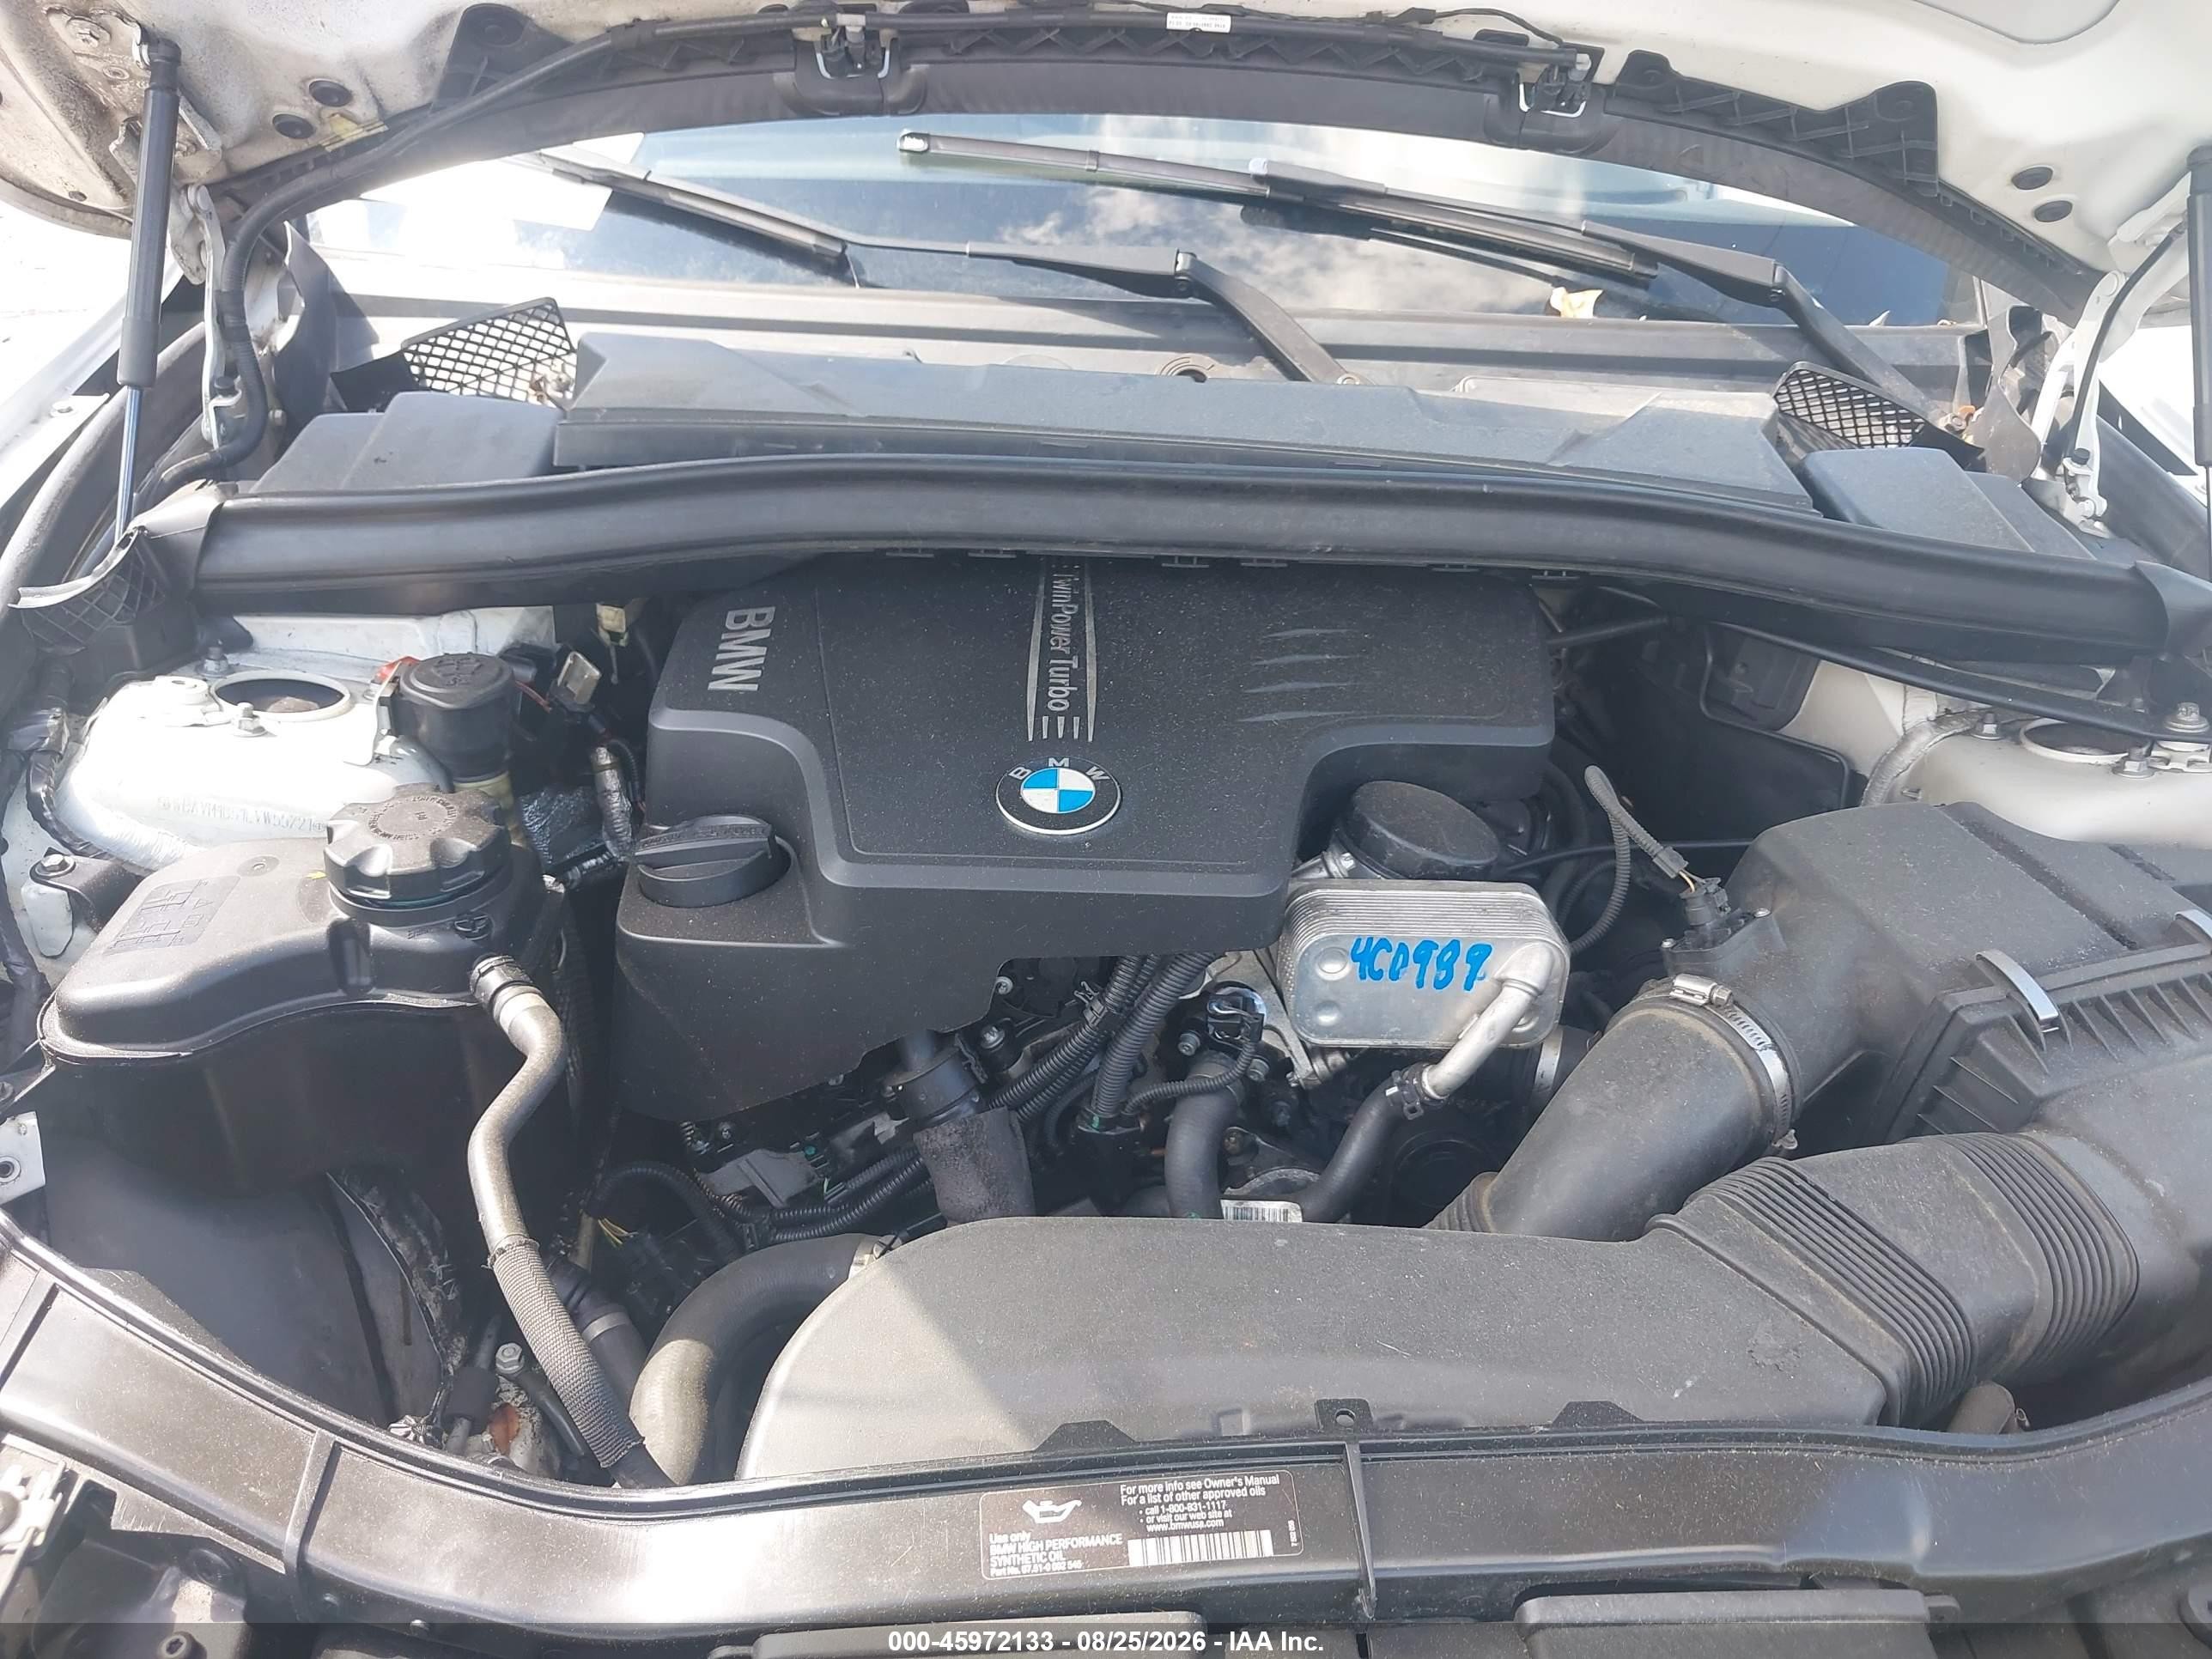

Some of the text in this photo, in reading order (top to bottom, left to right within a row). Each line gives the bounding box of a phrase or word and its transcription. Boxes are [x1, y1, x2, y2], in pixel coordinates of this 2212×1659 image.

[707, 606, 775, 692] BMW
[1047, 654, 1079, 712] Turbo
[1120, 1484, 1137, 1496] For
[1138, 1483, 1164, 1494] more
[1185, 1480, 1202, 1491] see
[1204, 1475, 1243, 1489] Owner's
[1244, 1474, 1280, 1487] Manual
[1121, 1485, 1267, 1506] For a list of other approved oils
[1145, 1499, 1226, 1516] call 1-800-831-1117
[1146, 1508, 1233, 1524] or visit our web site at
[1146, 1518, 1224, 1533] www.bmwusa.com
[989, 1533, 1123, 1557] BMW HIGH PERFORMANCE
[1009, 1530, 1031, 1545] only
[989, 1550, 1066, 1568] SYNTHETIC OIL
[989, 1566, 1007, 1577] Part
